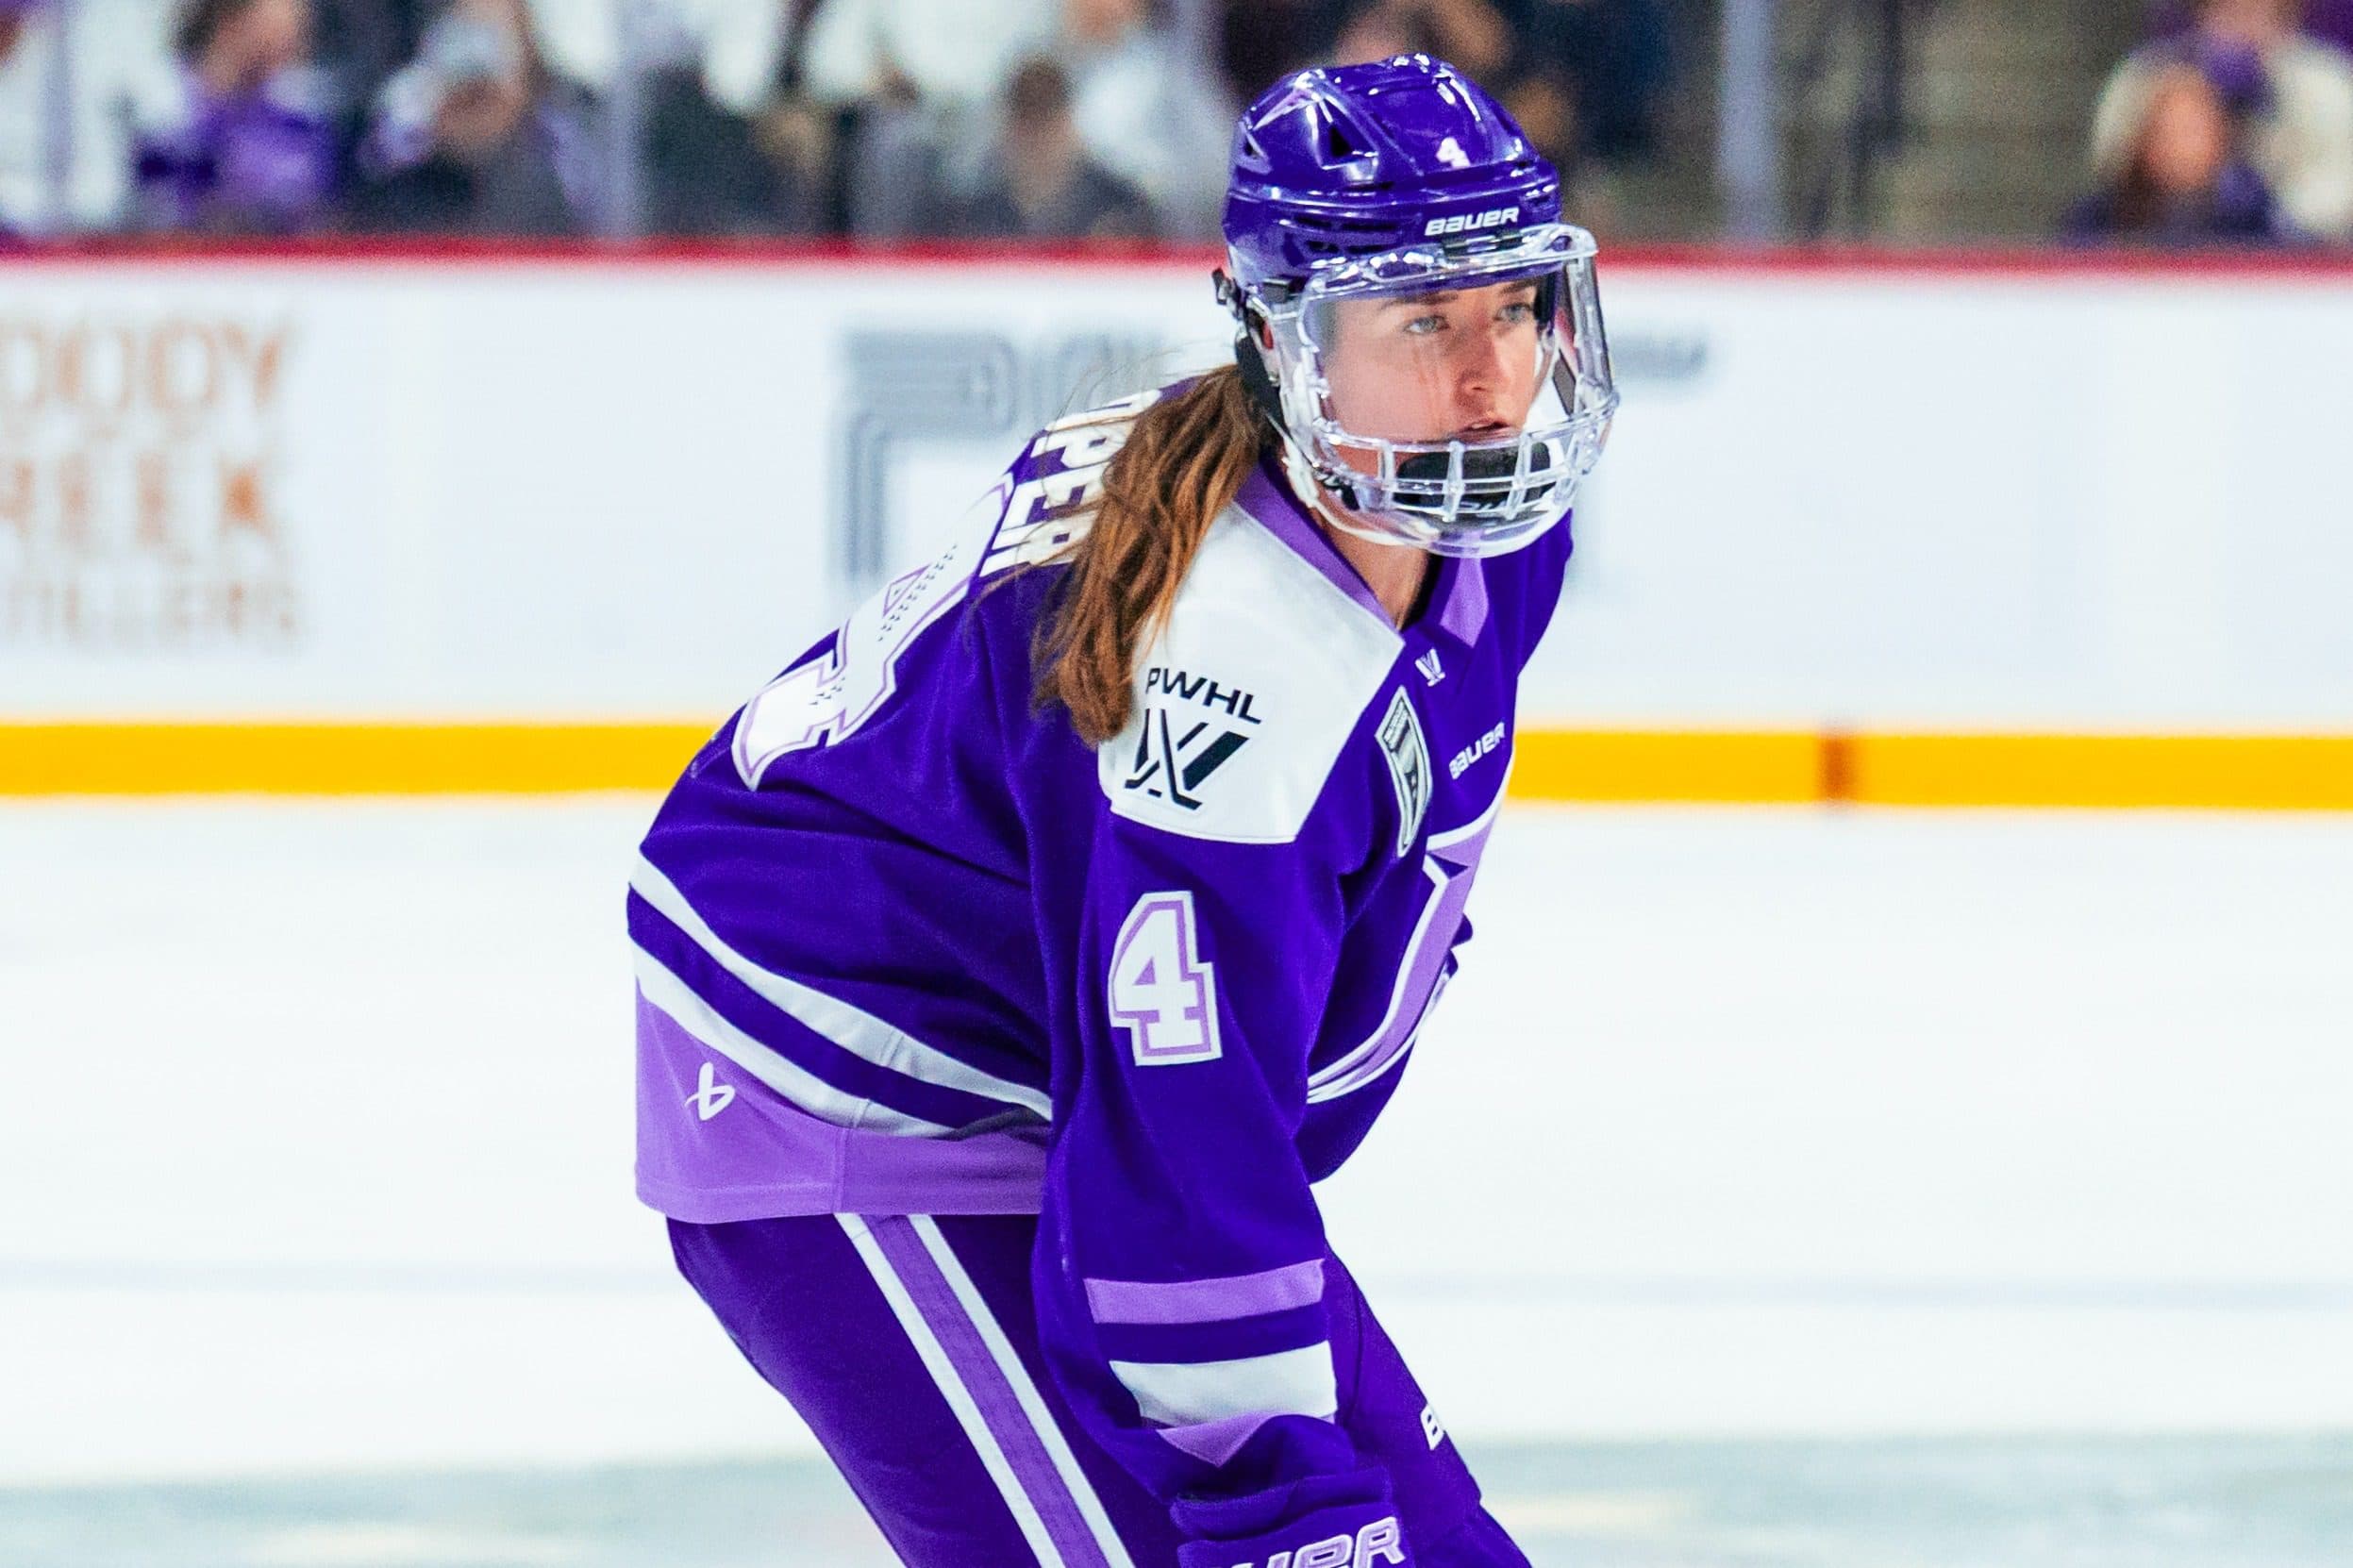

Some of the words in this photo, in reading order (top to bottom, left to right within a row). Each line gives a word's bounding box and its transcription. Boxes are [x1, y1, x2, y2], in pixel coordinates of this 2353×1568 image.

[1436, 137, 1471, 169] 4
[1424, 207, 1520, 236] BAUER
[1144, 667, 1261, 725] PWHL
[1448, 721, 1506, 780] BAUER
[1108, 890, 1224, 1067] 4
